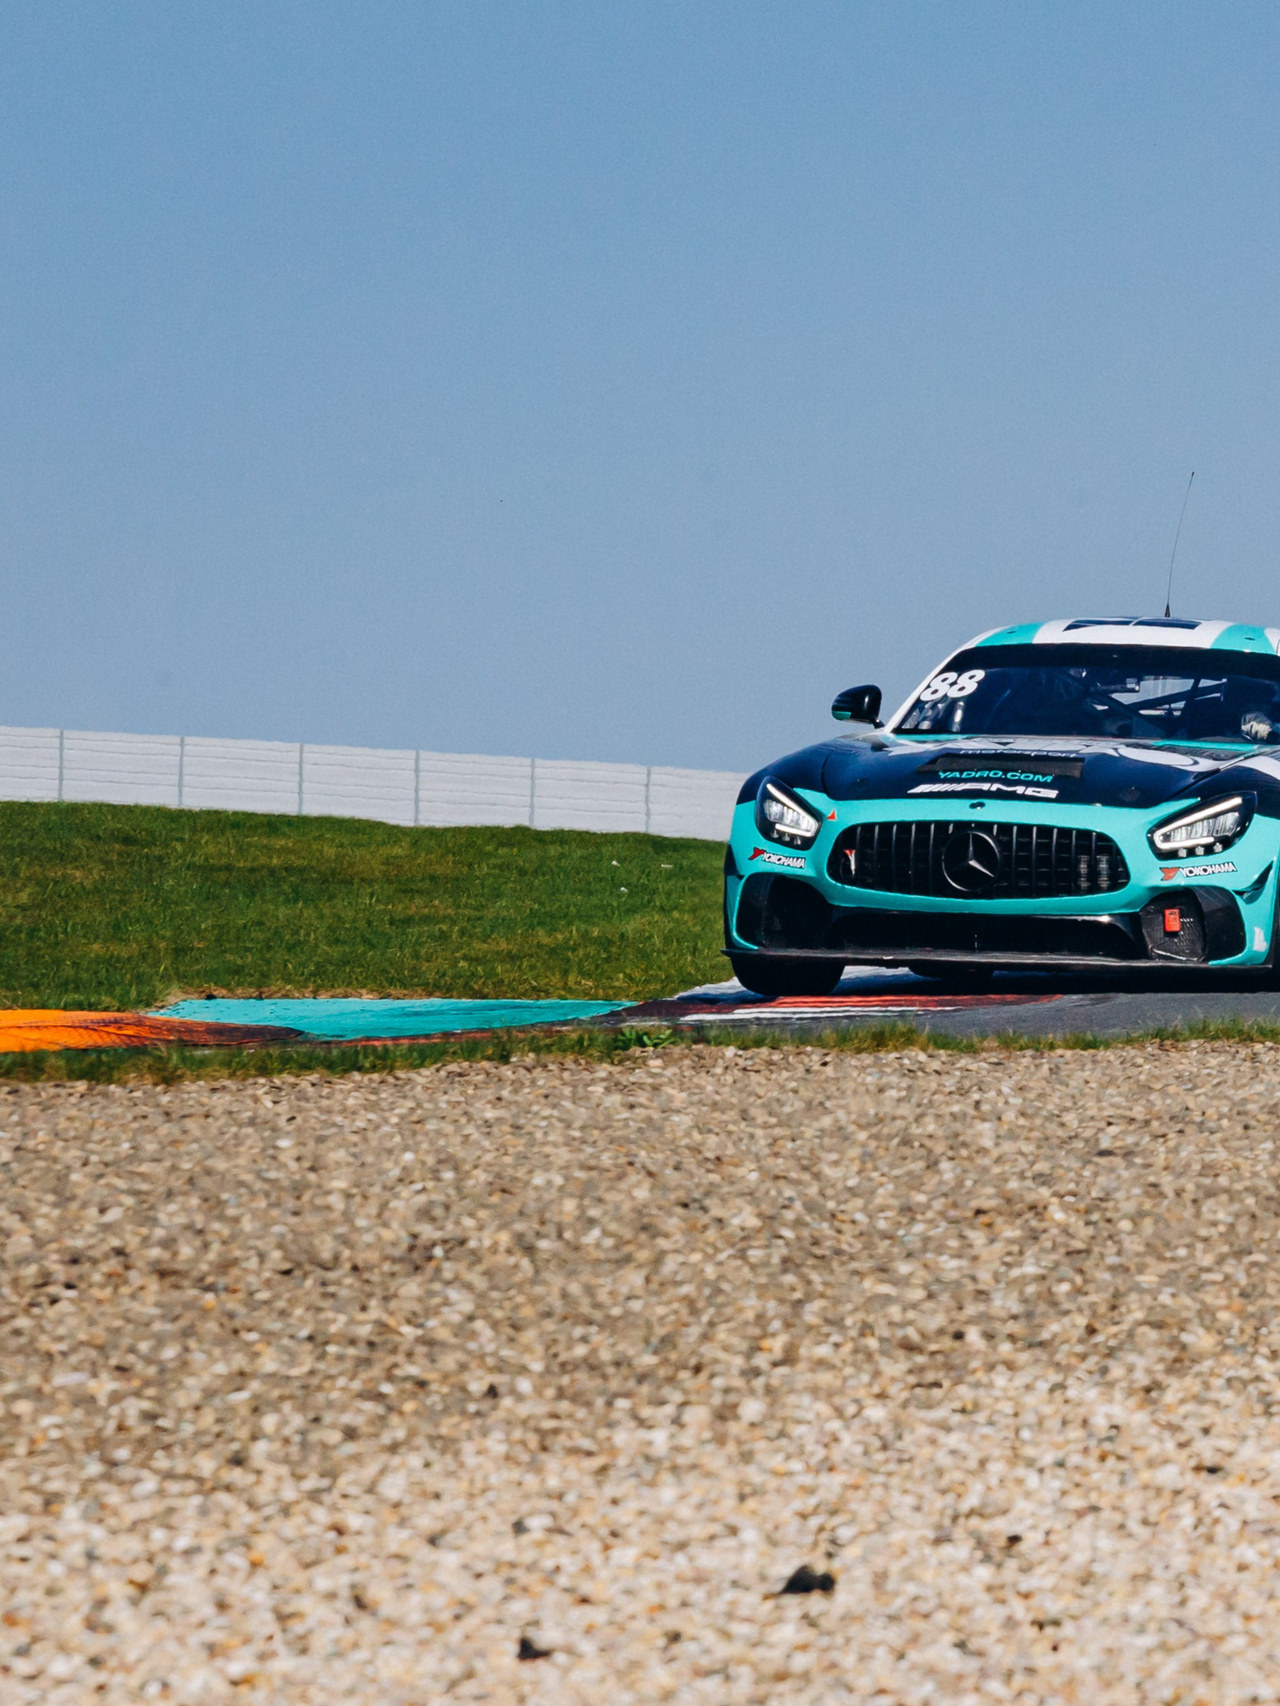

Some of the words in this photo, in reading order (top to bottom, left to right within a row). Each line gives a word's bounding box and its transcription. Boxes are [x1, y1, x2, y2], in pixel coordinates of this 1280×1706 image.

[920, 669, 985, 701] 88
[938, 770, 1053, 783] YADRO.COM
[956, 782, 1059, 799] AMG
[762, 852, 805, 869] YOKOHAMA
[1180, 862, 1237, 877] YOKOHAMA
